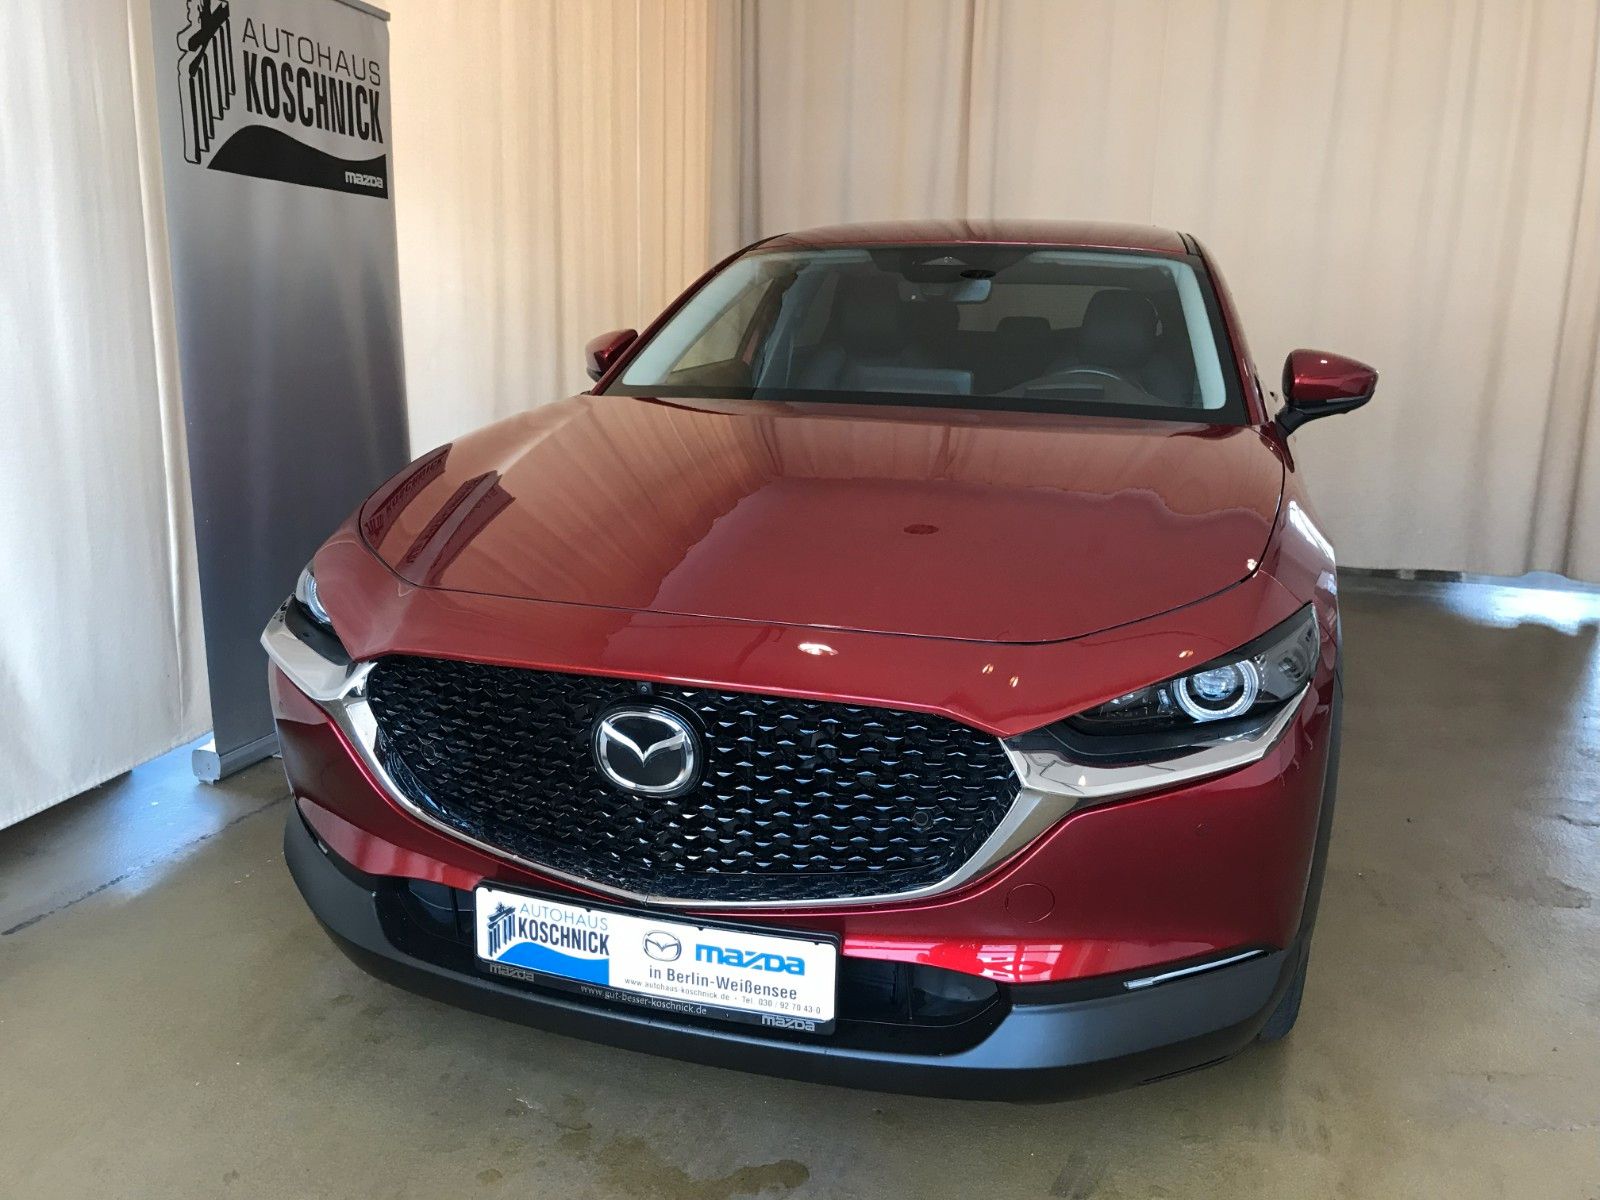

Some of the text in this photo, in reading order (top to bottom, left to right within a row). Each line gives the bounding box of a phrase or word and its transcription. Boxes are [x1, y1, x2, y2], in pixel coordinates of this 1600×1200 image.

[242, 17, 381, 86] AUTOHAUS
[242, 50, 384, 144] KOSCHNICK
[345, 171, 383, 189] mazda
[519, 903, 608, 931] AUTOHAUS
[518, 917, 610, 956] KOSCHNICK
[489, 963, 535, 982] mazda
[695, 943, 805, 976] mazda
[649, 965, 798, 1000] in Berlin-Weißensee
[580, 985, 707, 1015] www.gut-besser-koschnick.de
[758, 998, 773, 1007] 030
[761, 1013, 815, 1032] mazda
